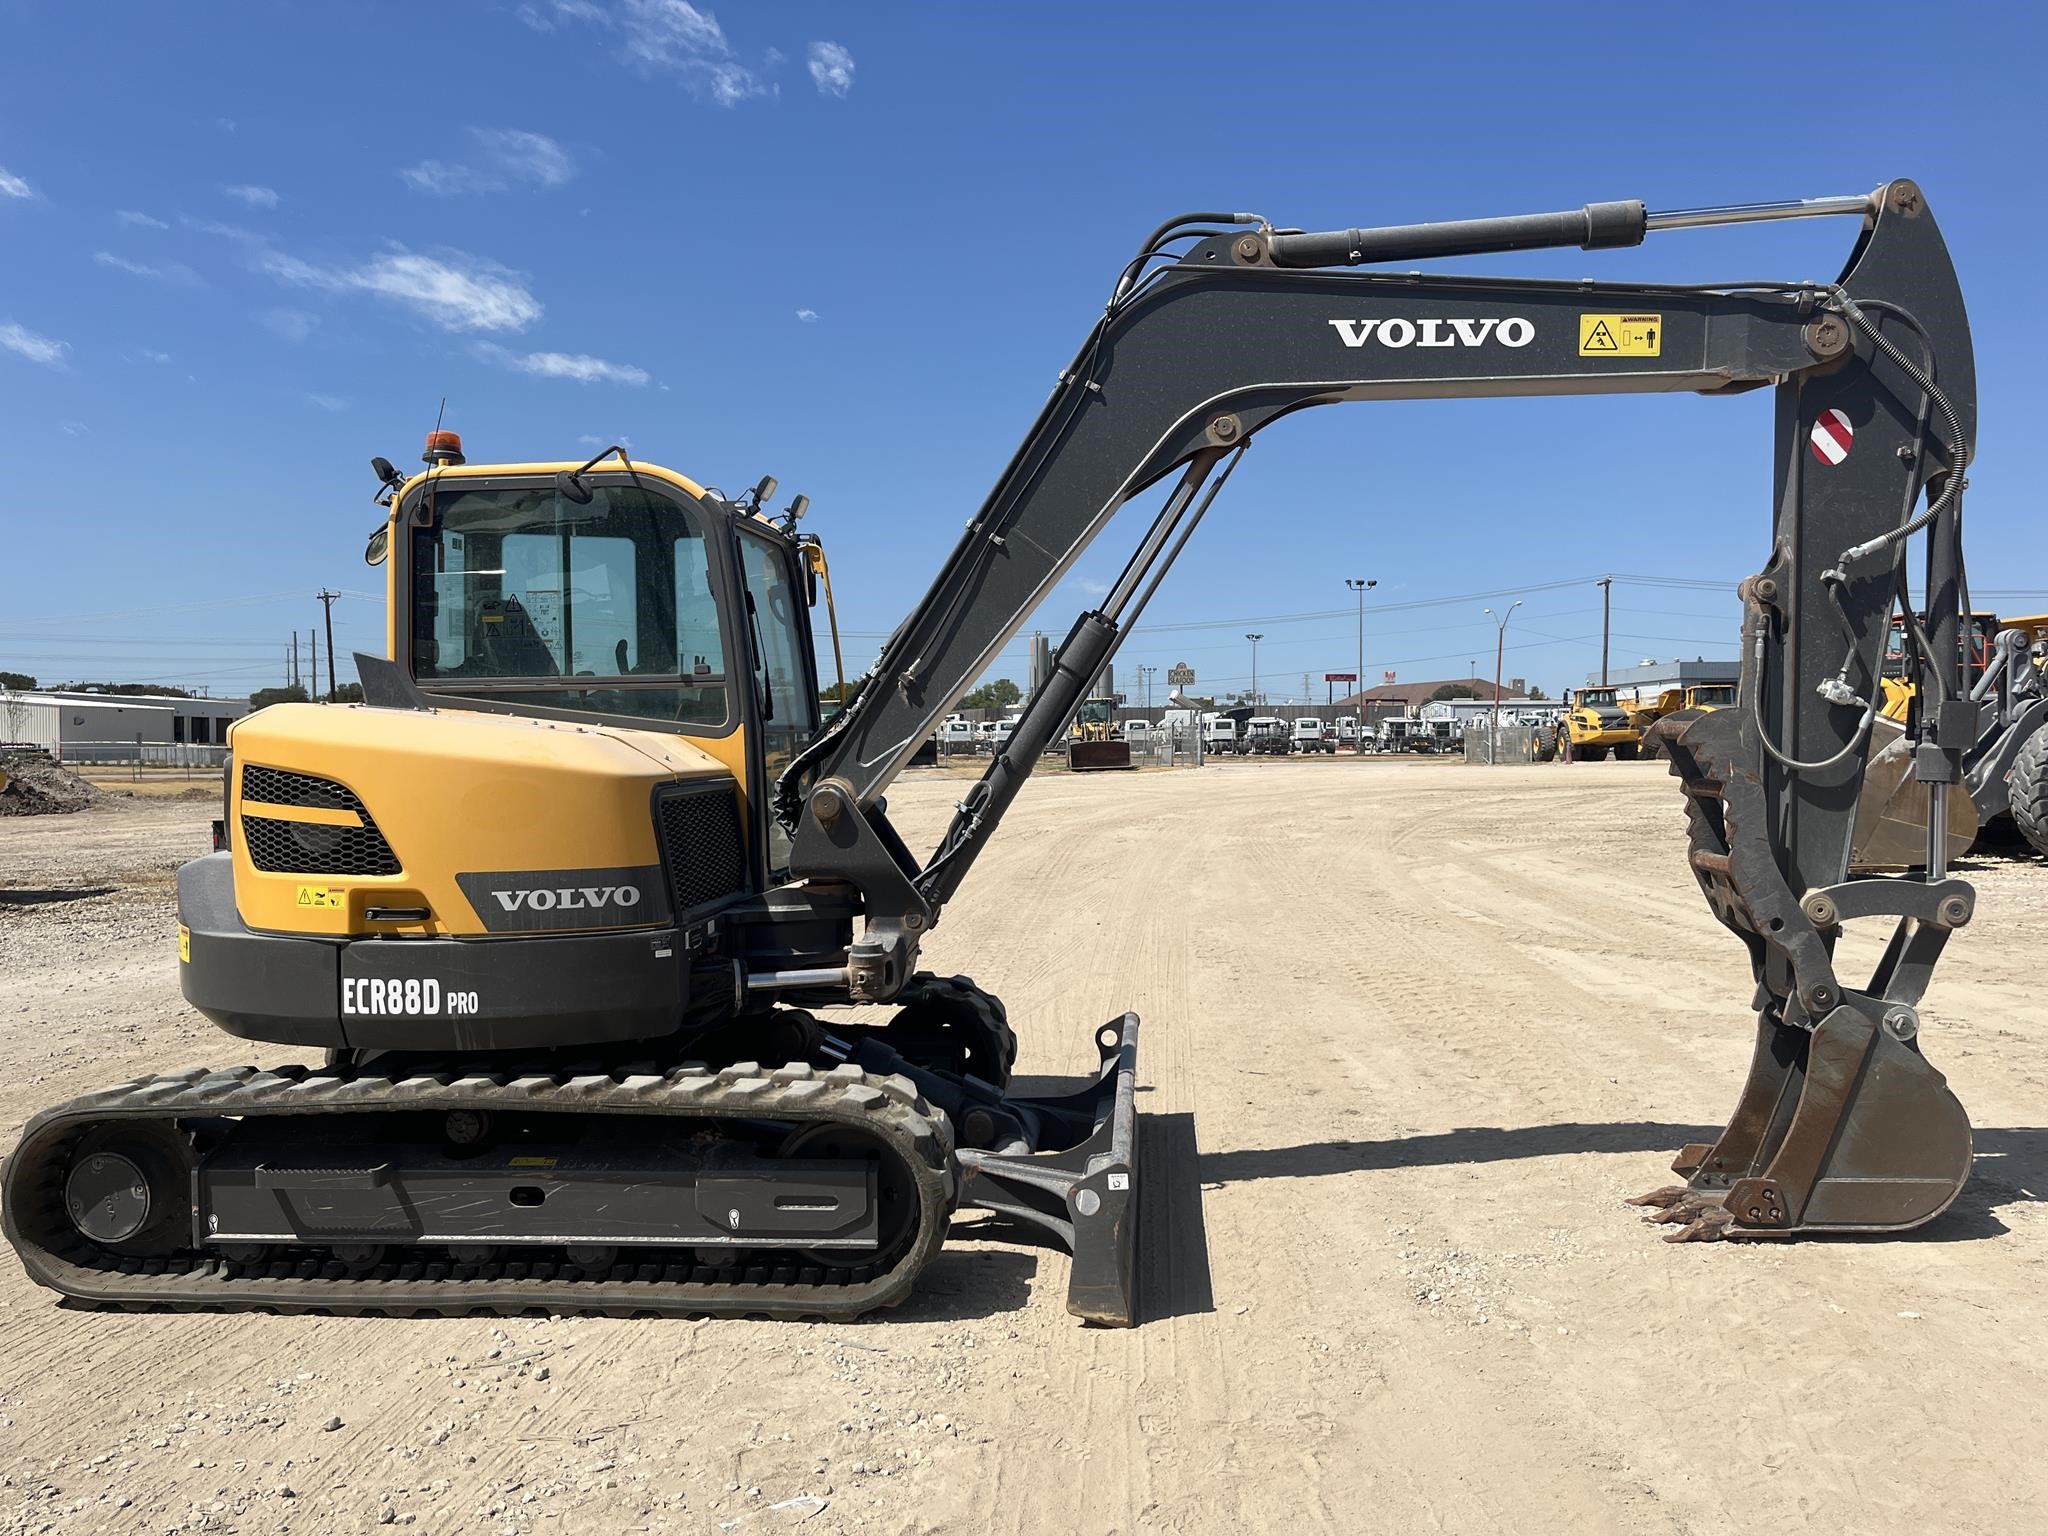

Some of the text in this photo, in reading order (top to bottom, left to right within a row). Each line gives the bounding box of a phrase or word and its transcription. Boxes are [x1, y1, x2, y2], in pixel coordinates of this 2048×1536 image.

[1328, 317, 1536, 348] VOLVO
[491, 885, 641, 911] VOLVO
[343, 978, 479, 1015] ECR88D PRO
